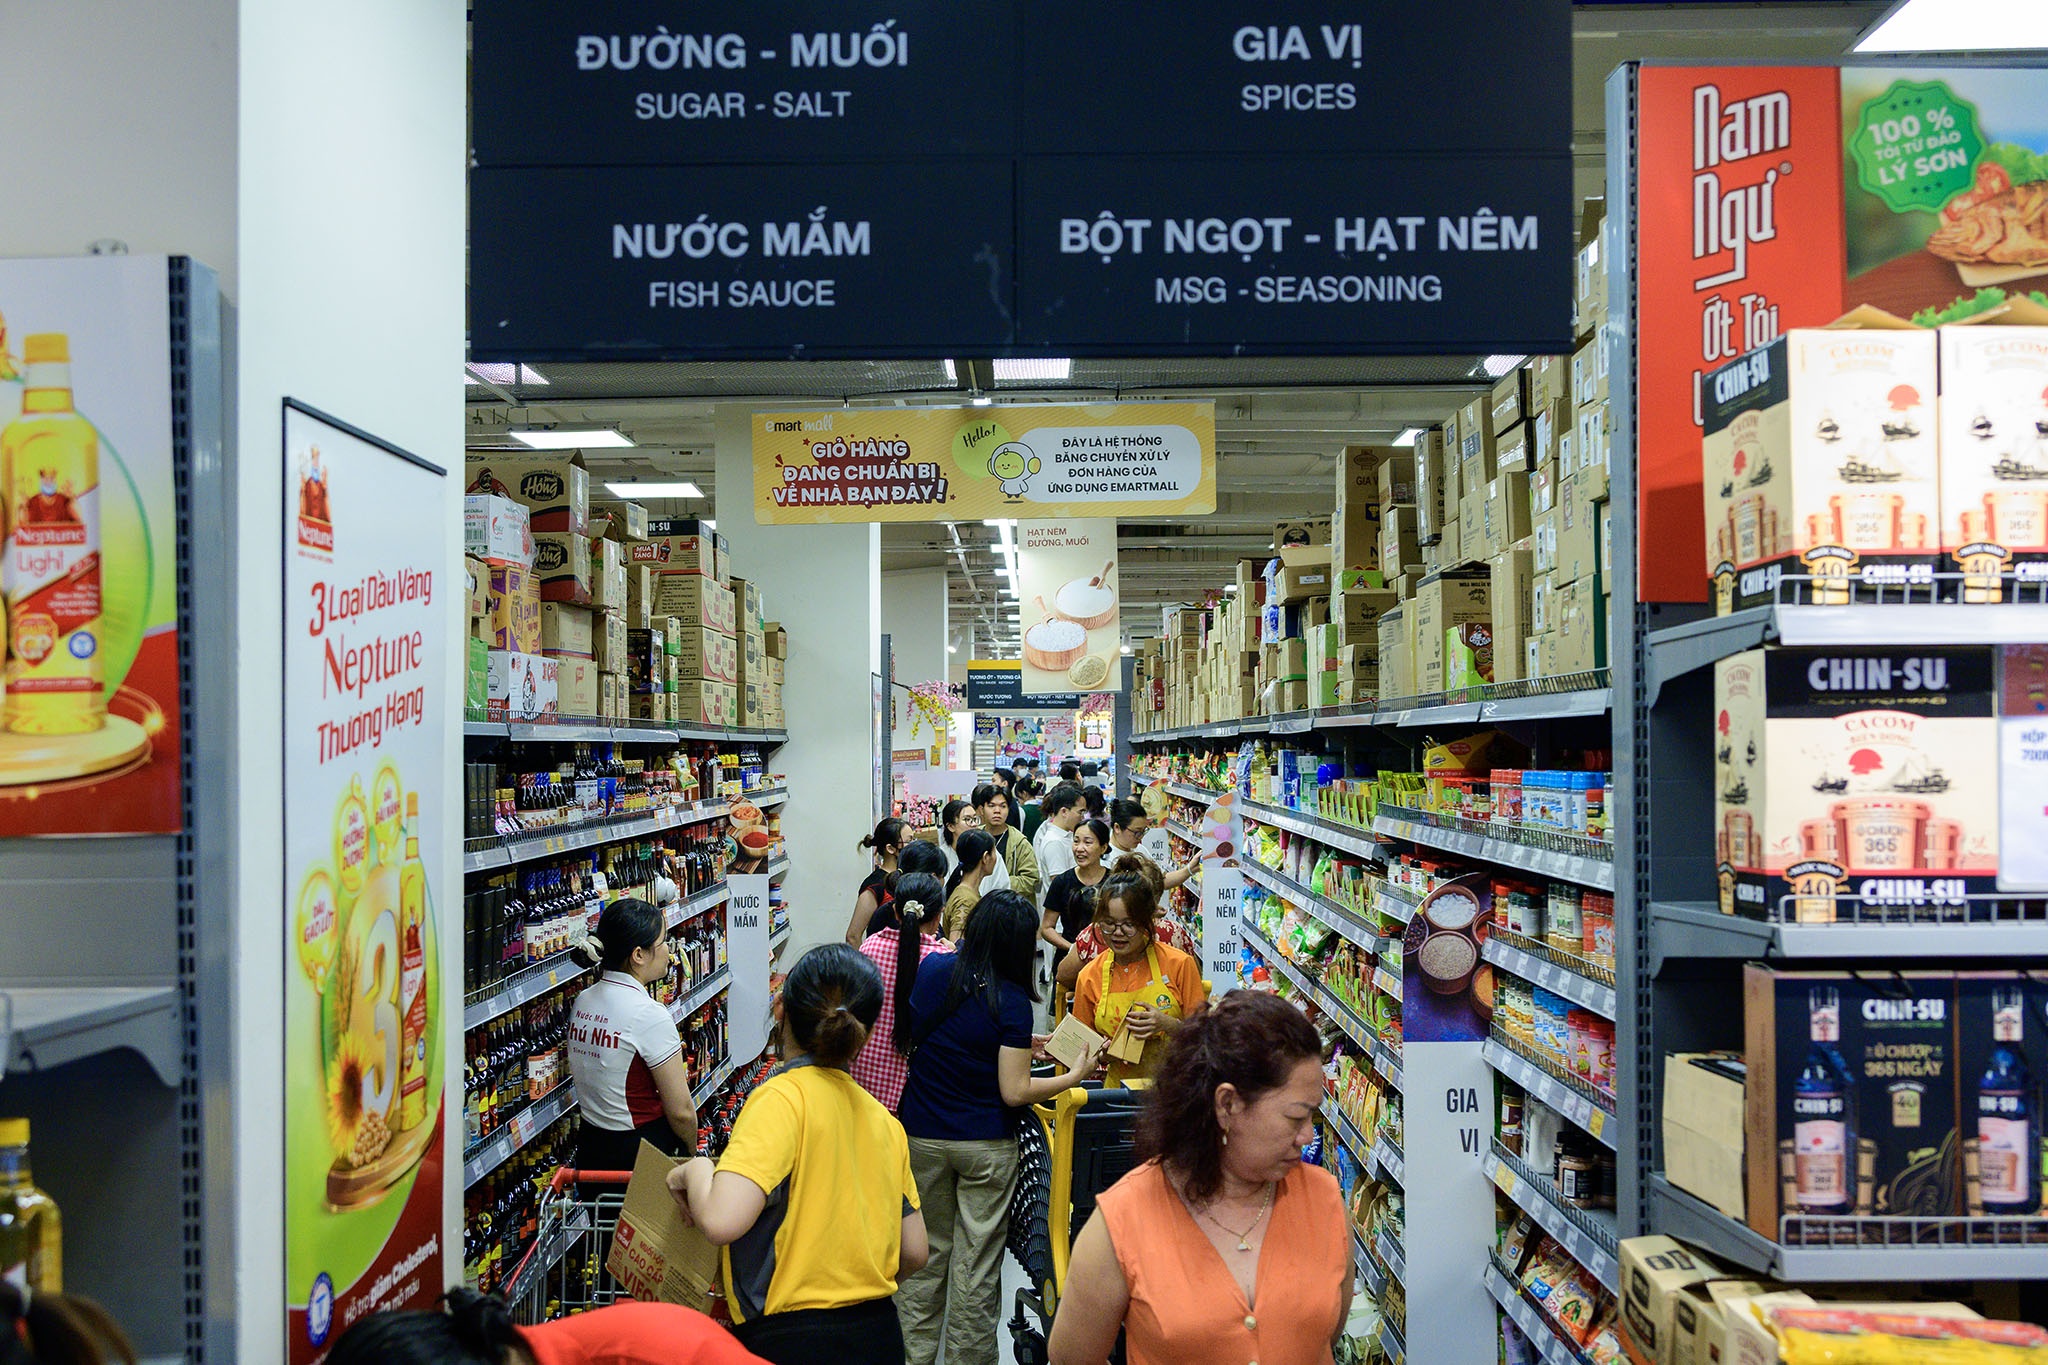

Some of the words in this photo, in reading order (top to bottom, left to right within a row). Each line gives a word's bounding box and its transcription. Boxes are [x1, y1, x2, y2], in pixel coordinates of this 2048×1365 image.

[575, 26, 747, 70] ĐƯỜNG
[790, 19, 909, 68] MUỐI
[1232, 25, 1312, 62] GIA
[1320, 25, 1363, 69] VỊ
[635, 92, 746, 120] SUGAR
[773, 91, 852, 119] SALT
[1240, 83, 1357, 111] SPICES
[1692, 83, 1791, 172] Nam
[1867, 114, 1921, 146] 100
[1925, 105, 1955, 132] %
[1877, 157, 1908, 186] LÝ
[1913, 147, 1968, 177] SƠN
[612, 213, 749, 259] NƯỚC
[763, 205, 871, 257] MẮM
[1059, 210, 1152, 264] BỘT
[1164, 217, 1292, 263] NGỌT
[1335, 216, 1426, 262] HẠT
[1437, 207, 1539, 252] NÊM
[649, 281, 719, 308] FISH
[727, 280, 836, 308] SAUCE
[1155, 277, 1227, 304] MSG
[1255, 275, 1443, 303] SEASONING
[1702, 293, 1738, 362] Ớt
[1739, 293, 1780, 351] Tỏi
[1715, 349, 1771, 404] CHIN-SU
[765, 419, 801, 432] emart
[803, 414, 834, 432] mall
[963, 424, 997, 449] Hello!
[811, 438, 848, 458] GIỎ
[850, 437, 908, 458] HÀNG
[1062, 436, 1087, 448] ĐÂY
[1089, 435, 1103, 447] LÀ
[1105, 436, 1120, 448] HỆ
[1122, 433, 1163, 447] THỐNG
[1055, 451, 1088, 463] BĂNG
[1091, 450, 1137, 463] CHUYỀN
[1138, 449, 1156, 462] XỬ
[1158, 449, 1171, 461] LÝ
[783, 464, 841, 482] ĐANG
[844, 458, 914, 480] CHUẨN
[918, 463, 937, 483] BỊ
[1068, 468, 1094, 478] ĐƠN
[1096, 466, 1130, 477] HÀNG
[1132, 464, 1157, 477] CỦA
[772, 482, 798, 503] VỀ
[801, 483, 844, 502] NHÀ
[847, 486, 888, 506] BẠN
[1048, 480, 1073, 493] ỨNG
[1075, 483, 1108, 495] DỤNG
[1110, 481, 1179, 493] EMARTMALL
[16, 527, 86, 545] Neptune
[299, 519, 333, 548] Neptune
[1027, 528, 1045, 538] HẠT
[1047, 526, 1067, 536] NÊM
[1065, 535, 1089, 546] MUỐI
[17, 550, 64, 578] Light
[309, 580, 326, 638] 3
[328, 583, 365, 626] Loại
[367, 568, 396, 612] Dầu
[398, 565, 432, 607] Vàng
[322, 629, 423, 700] Neptune
[1807, 657, 1947, 691] CHIN-SU
[316, 705, 382, 766] Thượng
[386, 685, 425, 732] Hạng
[733, 893, 760, 908] NƯỚC
[1218, 888, 1237, 902] HẠT
[1860, 878, 1966, 906] CHIN-SU
[733, 911, 758, 928] MẮM
[1216, 906, 1237, 918] NÊM
[1230, 924, 1237, 936] &
[1219, 940, 1237, 955] BỘT
[1213, 961, 1237, 975] NGỌT
[576, 1010, 592, 1021] Nước
[569, 1022, 587, 1043] hú
[591, 1027, 621, 1049] Nhĩ
[1446, 1087, 1479, 1113] GIA
[1459, 1128, 1479, 1157] VỊ
[628, 1248, 646, 1270] CAO
[646, 1263, 664, 1285] CẤP
